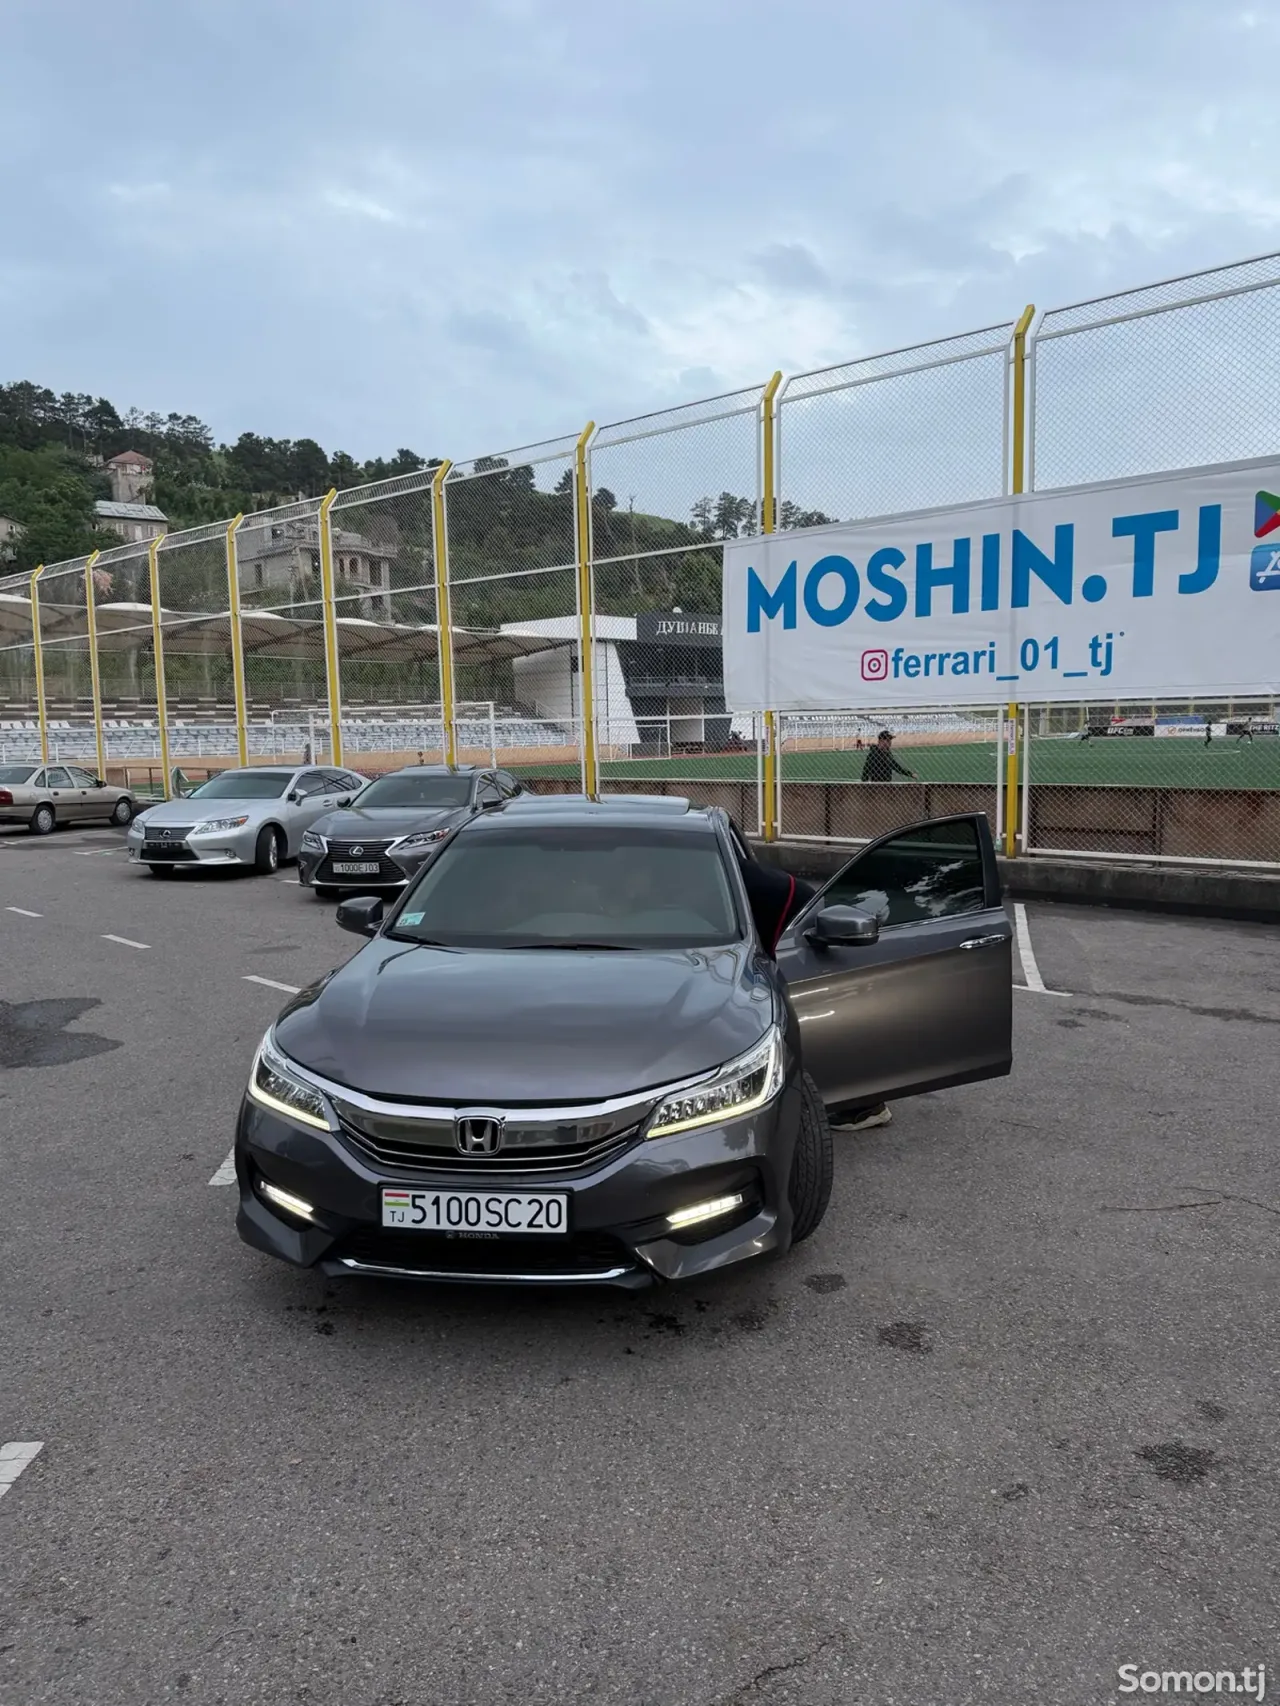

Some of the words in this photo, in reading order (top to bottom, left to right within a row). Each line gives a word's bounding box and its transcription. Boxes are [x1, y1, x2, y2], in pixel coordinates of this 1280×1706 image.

[747, 503, 1222, 633] MOSHIN.TJ
[891, 632, 1114, 681] ferrari_01_tj
[390, 1211, 405, 1223] TJ
[411, 1194, 562, 1229] 5100SC20
[458, 1231, 500, 1240] HONDA
